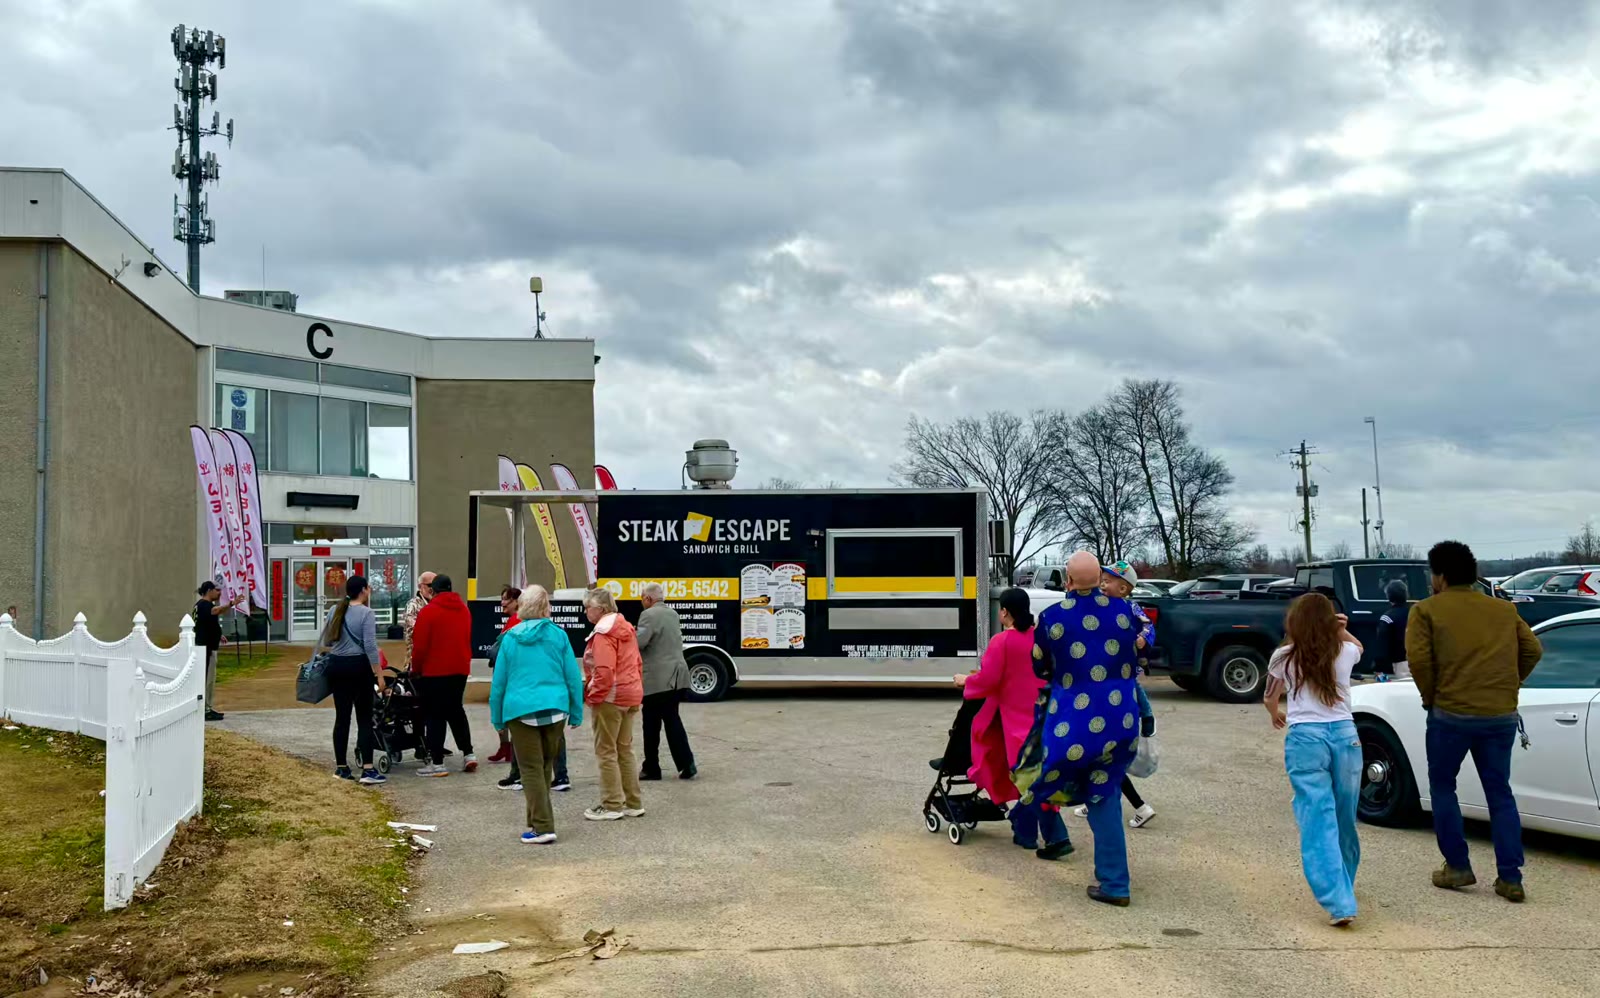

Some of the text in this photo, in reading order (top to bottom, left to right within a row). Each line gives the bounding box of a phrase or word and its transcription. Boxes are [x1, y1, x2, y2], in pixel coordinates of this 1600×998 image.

[306, 322, 334, 360] C
[618, 519, 791, 542] STEAK ESCAPE
[683, 544, 760, 554] SANDWICH GRILL
